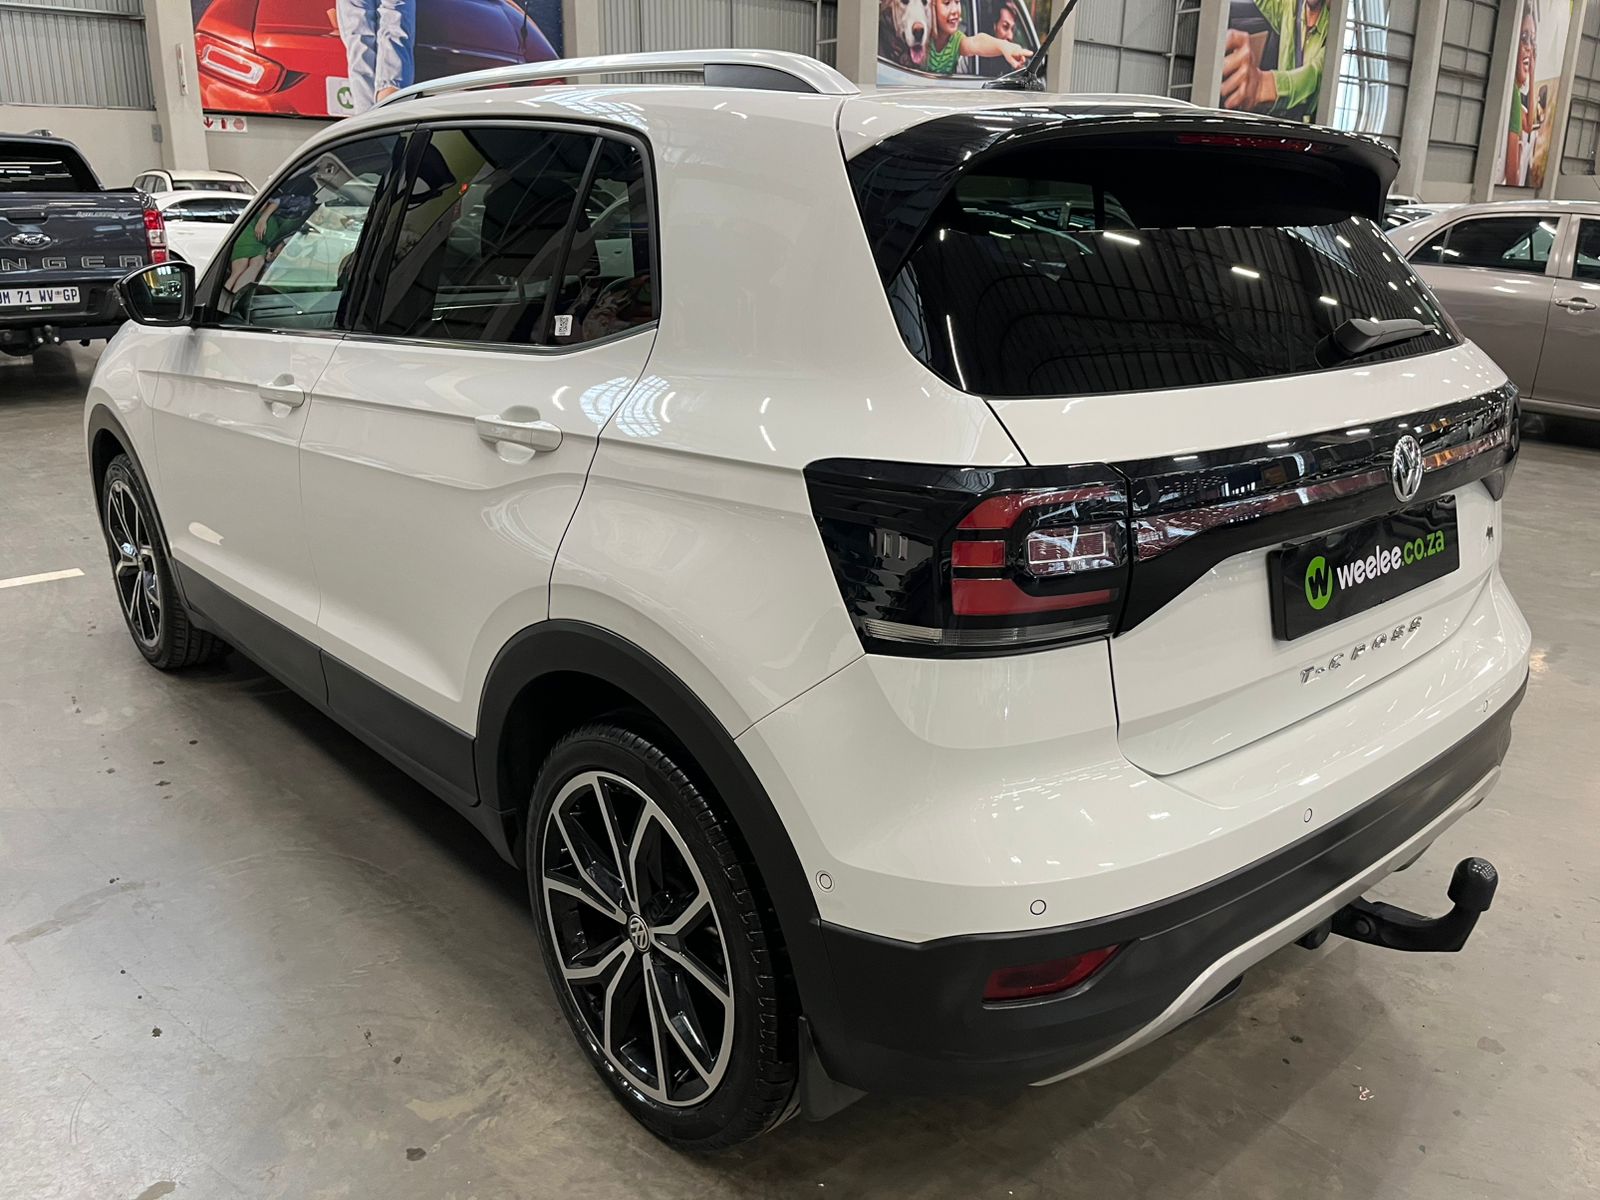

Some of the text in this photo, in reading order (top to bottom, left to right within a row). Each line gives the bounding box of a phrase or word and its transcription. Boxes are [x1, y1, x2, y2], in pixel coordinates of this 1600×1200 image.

[17, 290, 33, 303] 71
[39, 289, 54, 302] WV
[63, 288, 78, 302] GP
[1337, 530, 1445, 590] weelee.co.za
[1300, 615, 1422, 684] T-CROSS
